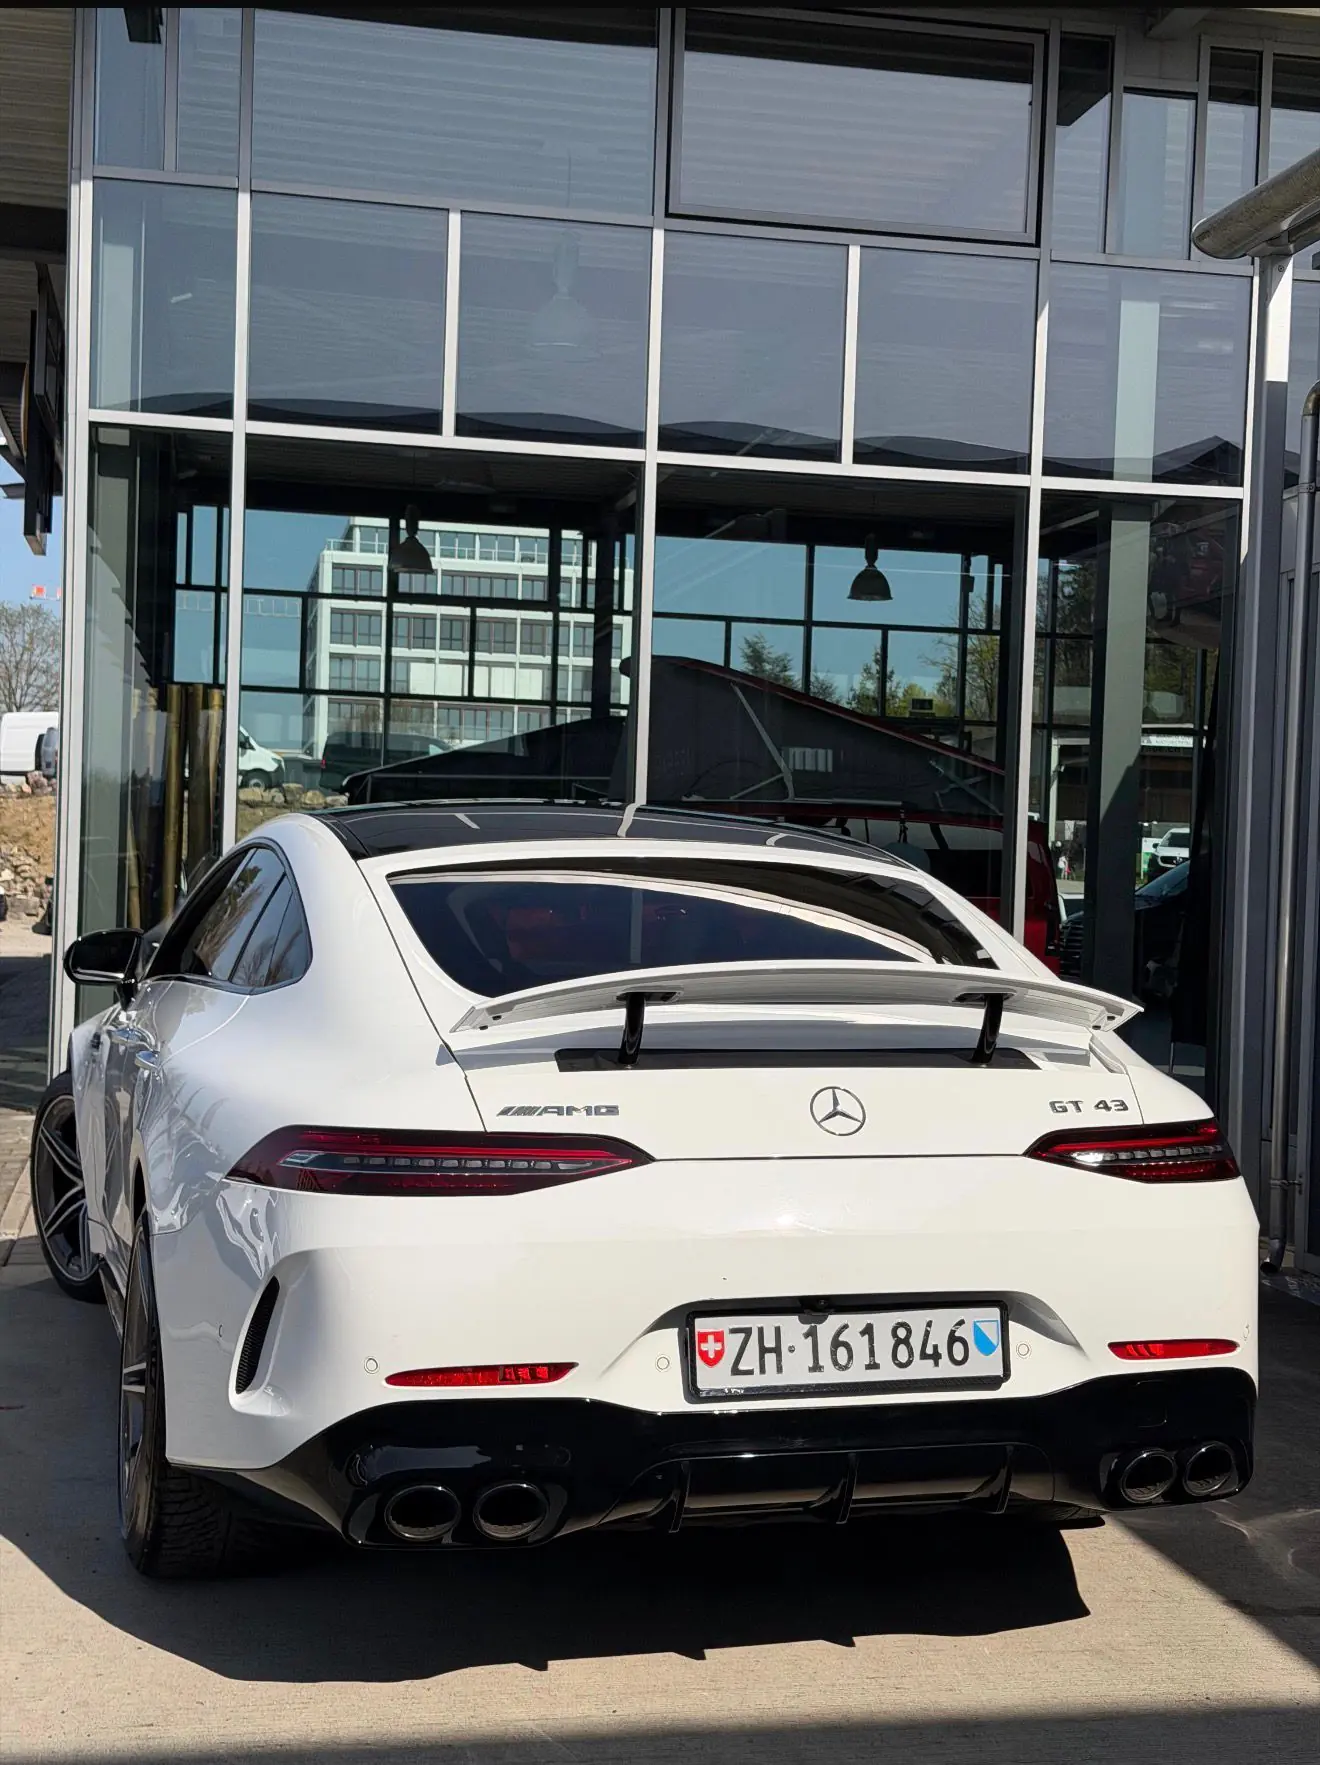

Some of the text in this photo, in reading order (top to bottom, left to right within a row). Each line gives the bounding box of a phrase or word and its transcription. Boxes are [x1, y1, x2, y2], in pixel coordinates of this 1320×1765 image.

[536, 1104, 620, 1117] AMG
[1048, 1099, 1129, 1114] GT 43
